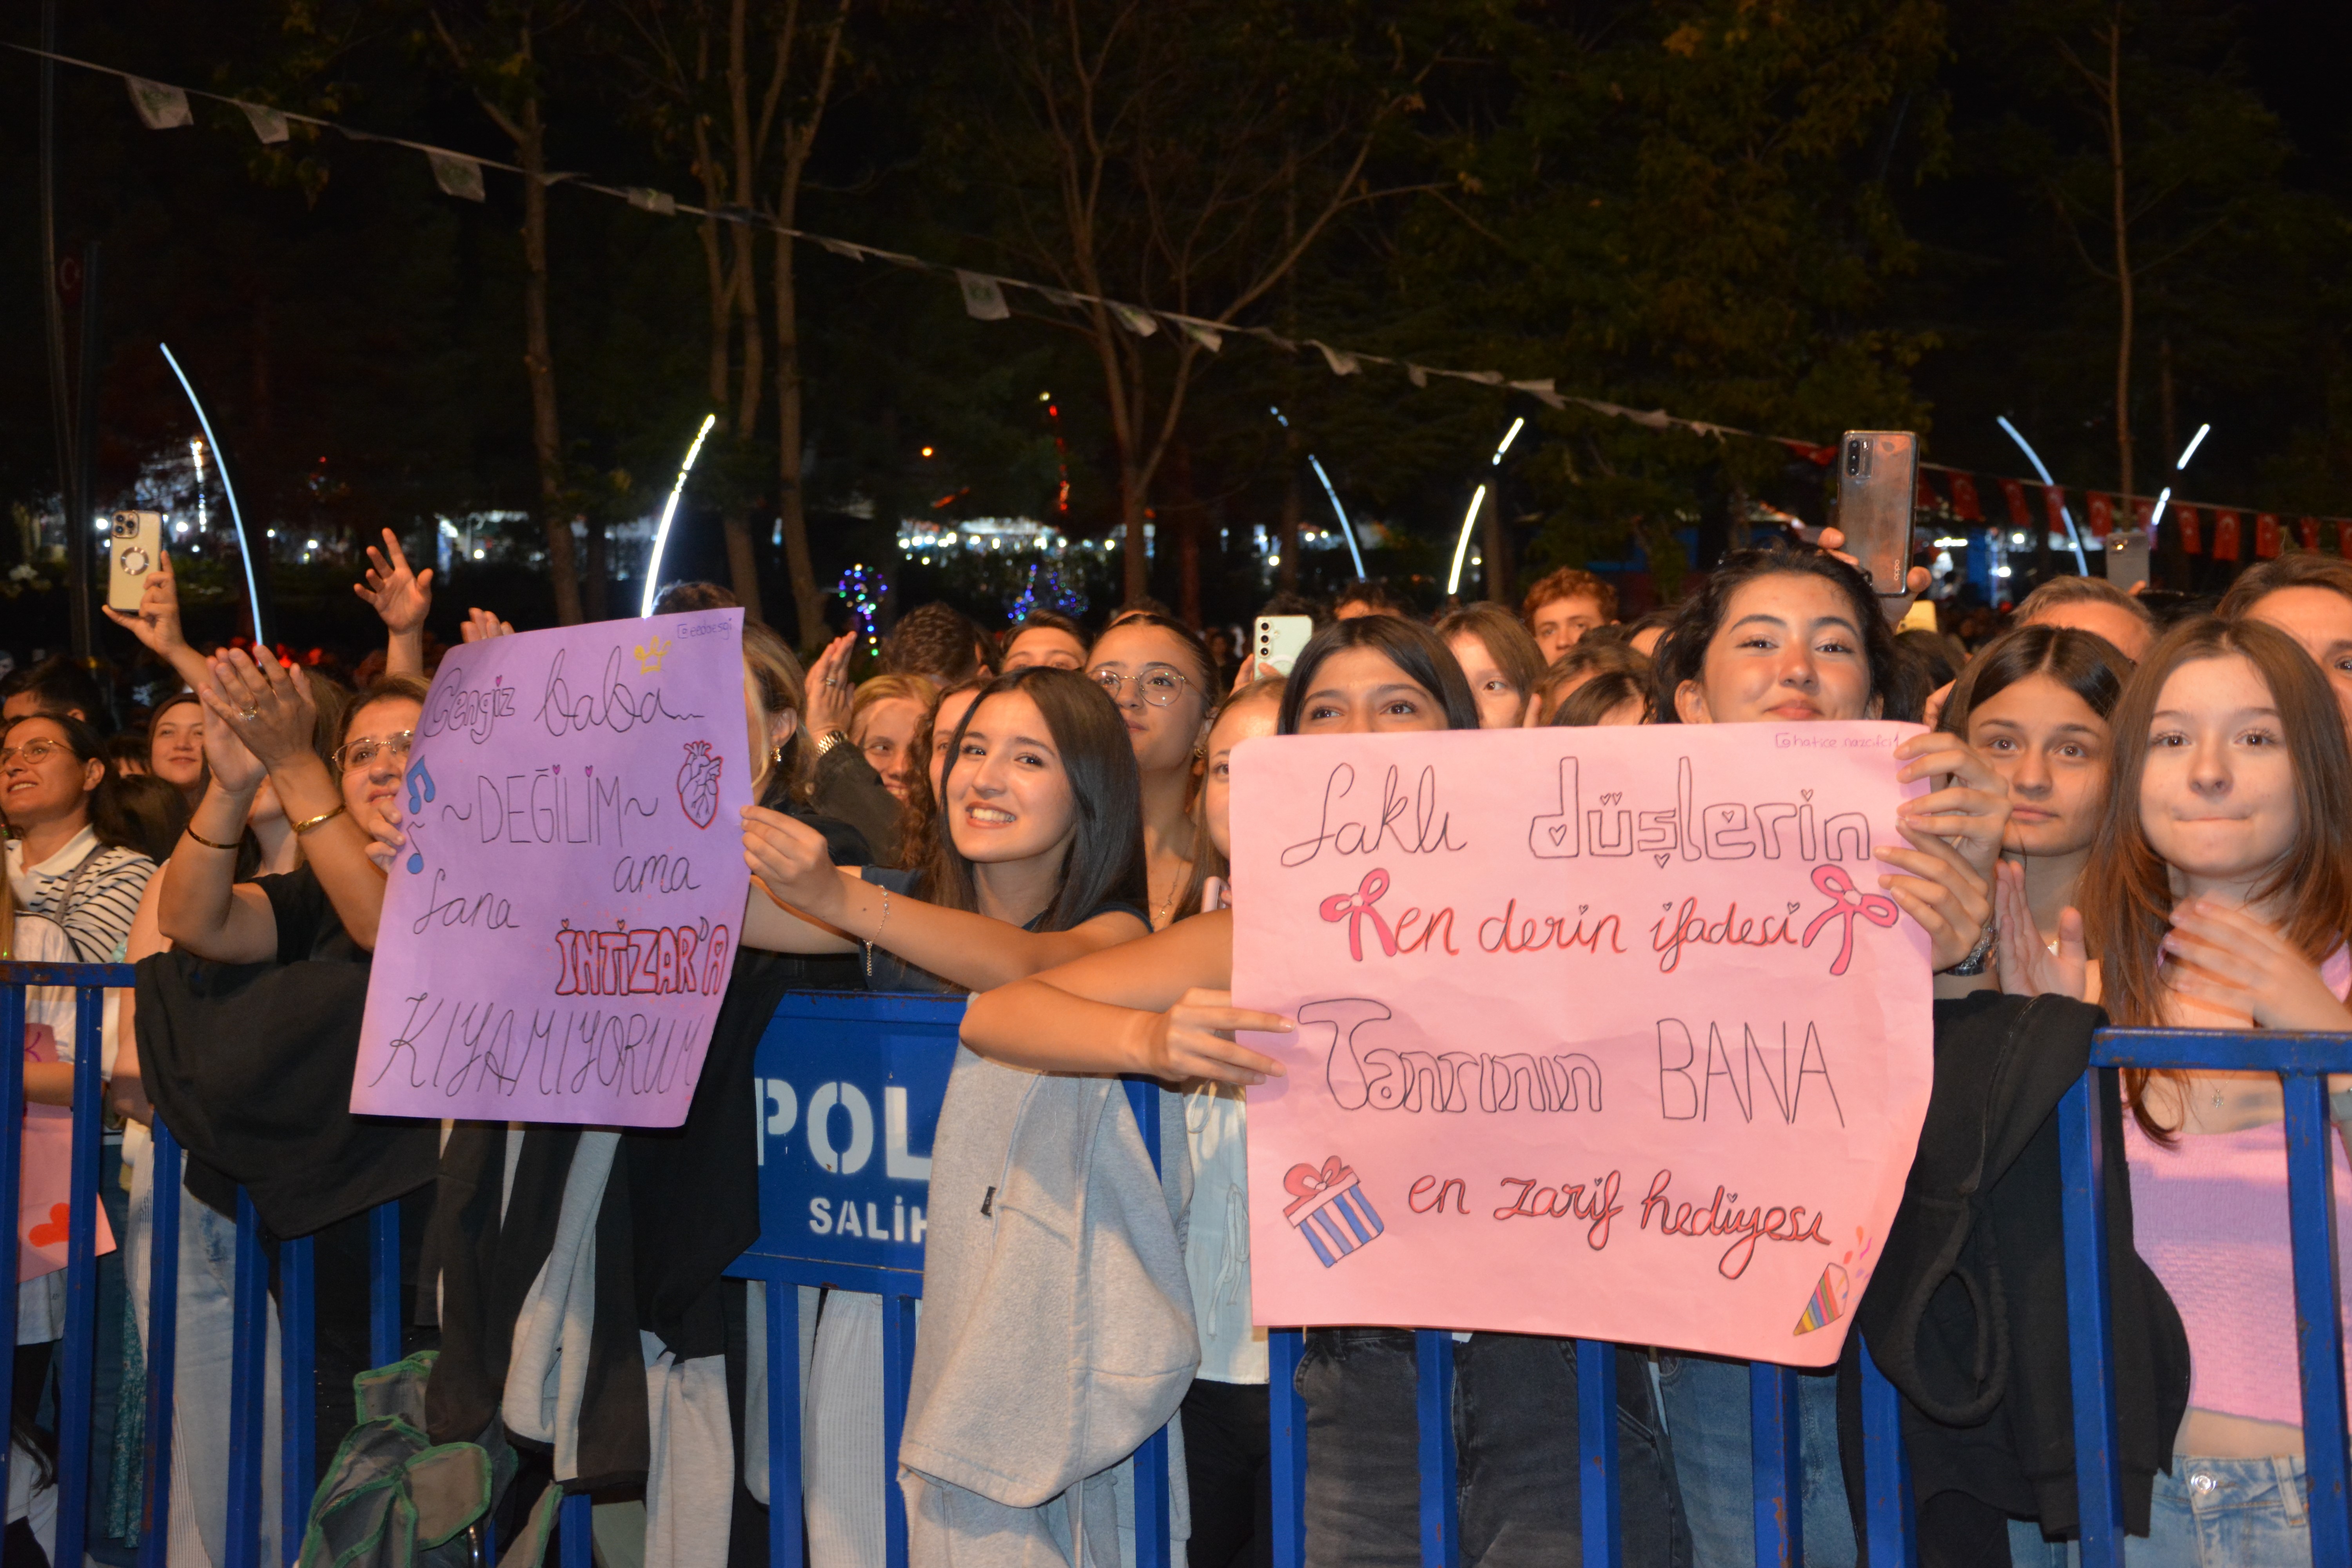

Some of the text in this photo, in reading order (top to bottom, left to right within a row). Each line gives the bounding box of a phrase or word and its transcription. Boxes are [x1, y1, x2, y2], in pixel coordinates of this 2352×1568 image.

[423, 668, 515, 744] Cengiz
[1281, 756, 1871, 869] Saklı düşlerin
[413, 868, 521, 935] Sana
[614, 854, 702, 893] ama
[1396, 896, 1800, 973] en derin ifadesi
[368, 992, 705, 1098] KIYAMIYORUM
[1656, 1018, 1845, 1128] BANA
[1408, 1174, 1470, 1214] en
